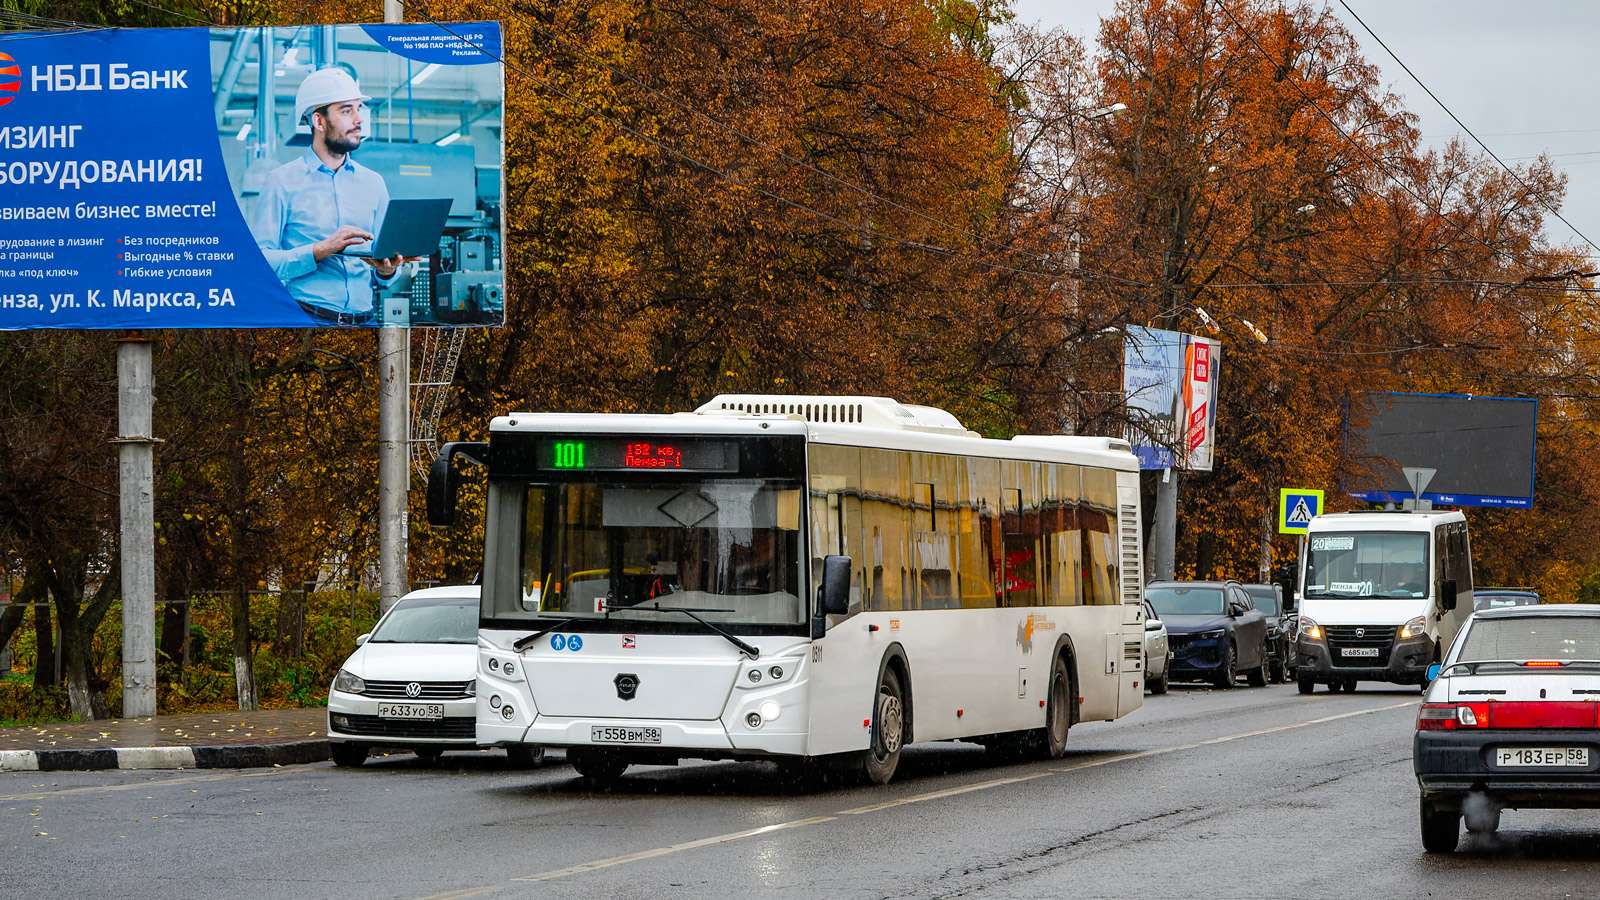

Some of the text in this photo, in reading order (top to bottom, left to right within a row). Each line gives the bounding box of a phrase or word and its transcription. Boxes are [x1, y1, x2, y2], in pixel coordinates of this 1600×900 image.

[32, 63, 188, 92] НБД Банк
[0, 201, 216, 220] виваем бизнес вместе!
[67, 238, 104, 246] лизинг
[124, 236, 219, 248] Без посредников
[8, 252, 54, 262] границы
[124, 252, 234, 262] Выгодные % ставки
[19, 270, 44, 279] «под
[46, 269, 78, 277] ключ»
[124, 268, 212, 279] Гибкие условия
[0, 288, 236, 313] нза, ул. К. Маркса, 5А
[555, 443, 584, 467] 101
[625, 454, 681, 467] Пенза-1
[1313, 540, 1324, 550] 20
[1360, 582, 1372, 596] 20
[646, 729, 656, 738] 58
[1568, 750, 1583, 760] 58
